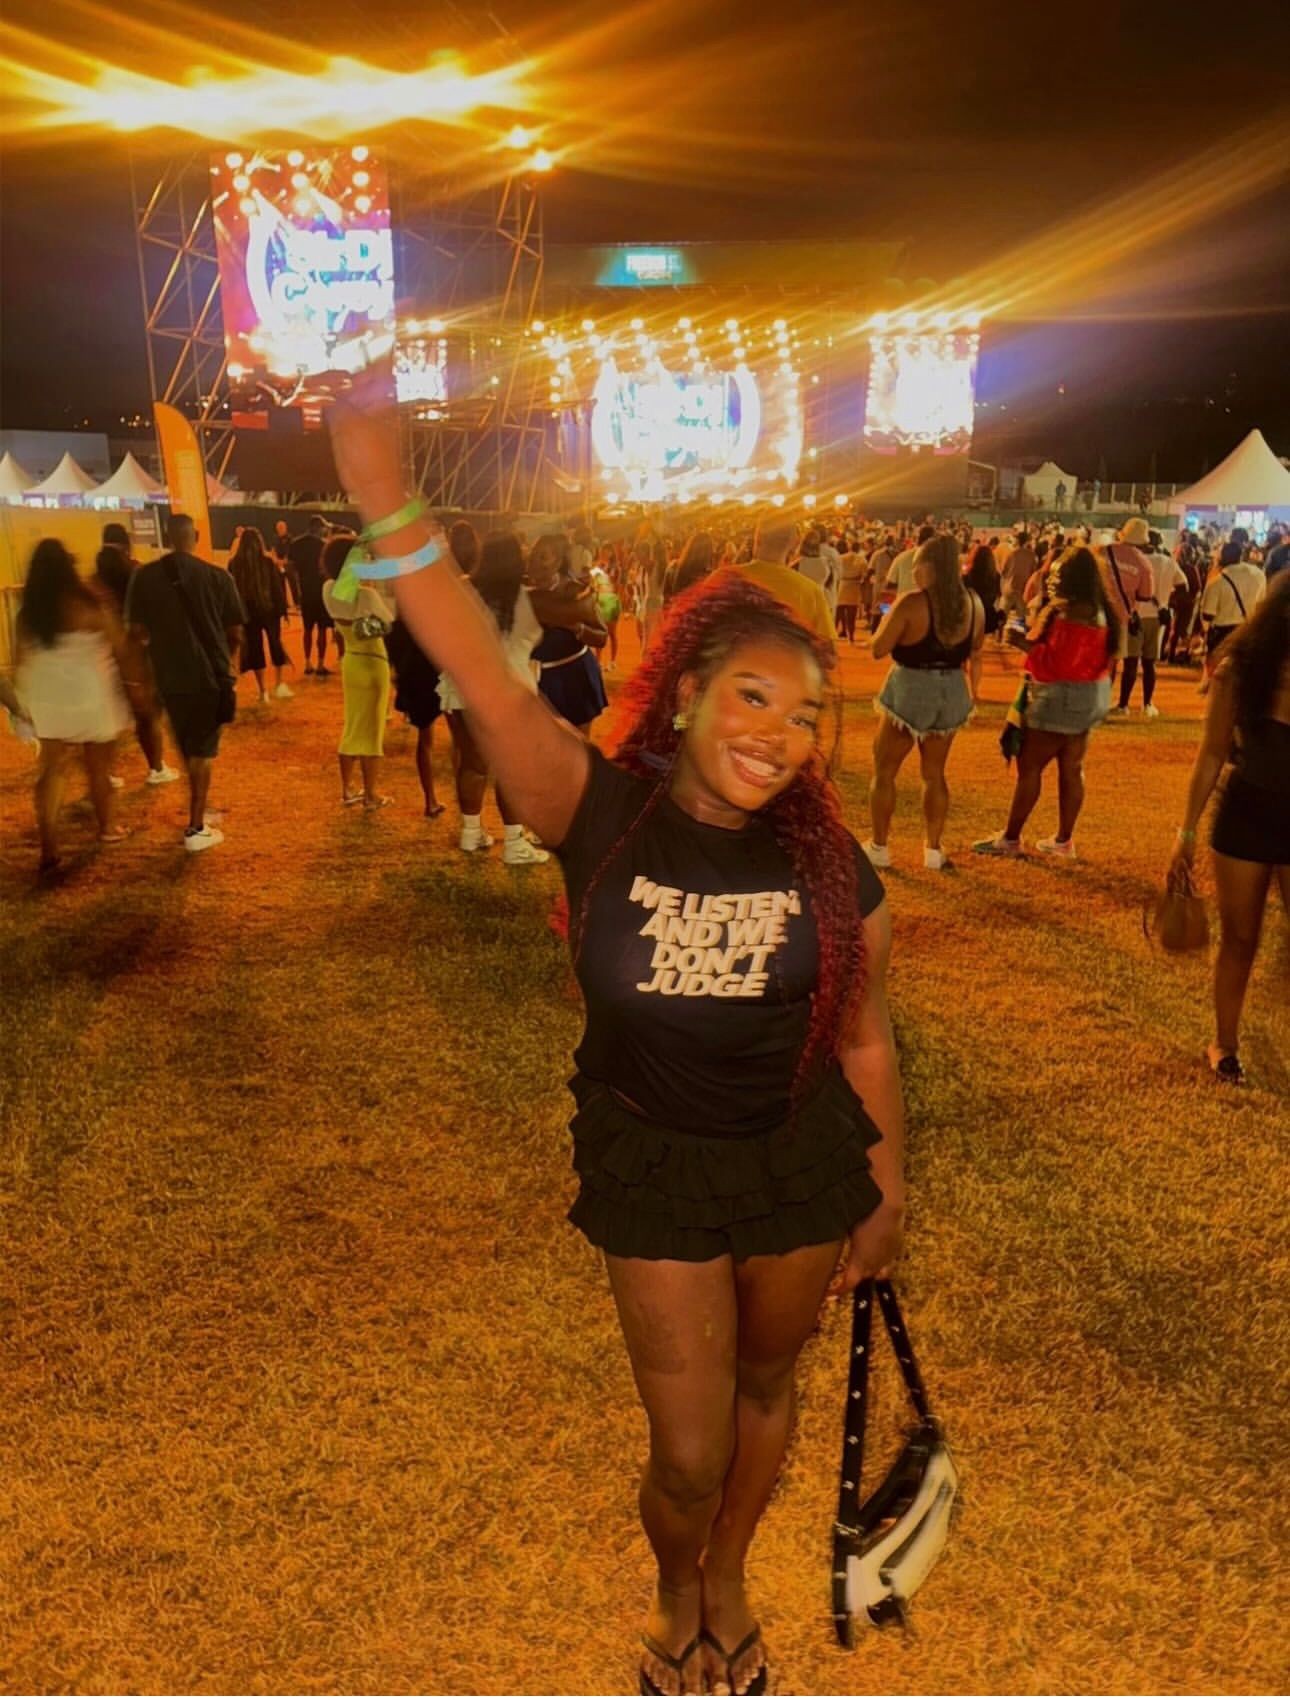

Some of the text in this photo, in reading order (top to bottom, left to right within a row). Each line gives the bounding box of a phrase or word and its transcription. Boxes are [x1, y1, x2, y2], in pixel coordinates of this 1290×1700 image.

[629, 876, 801, 922] WE LISTEN
[639, 912, 788, 947] AND WE
[651, 943, 776, 974] DON'T
[636, 969, 769, 997] JUDGE
